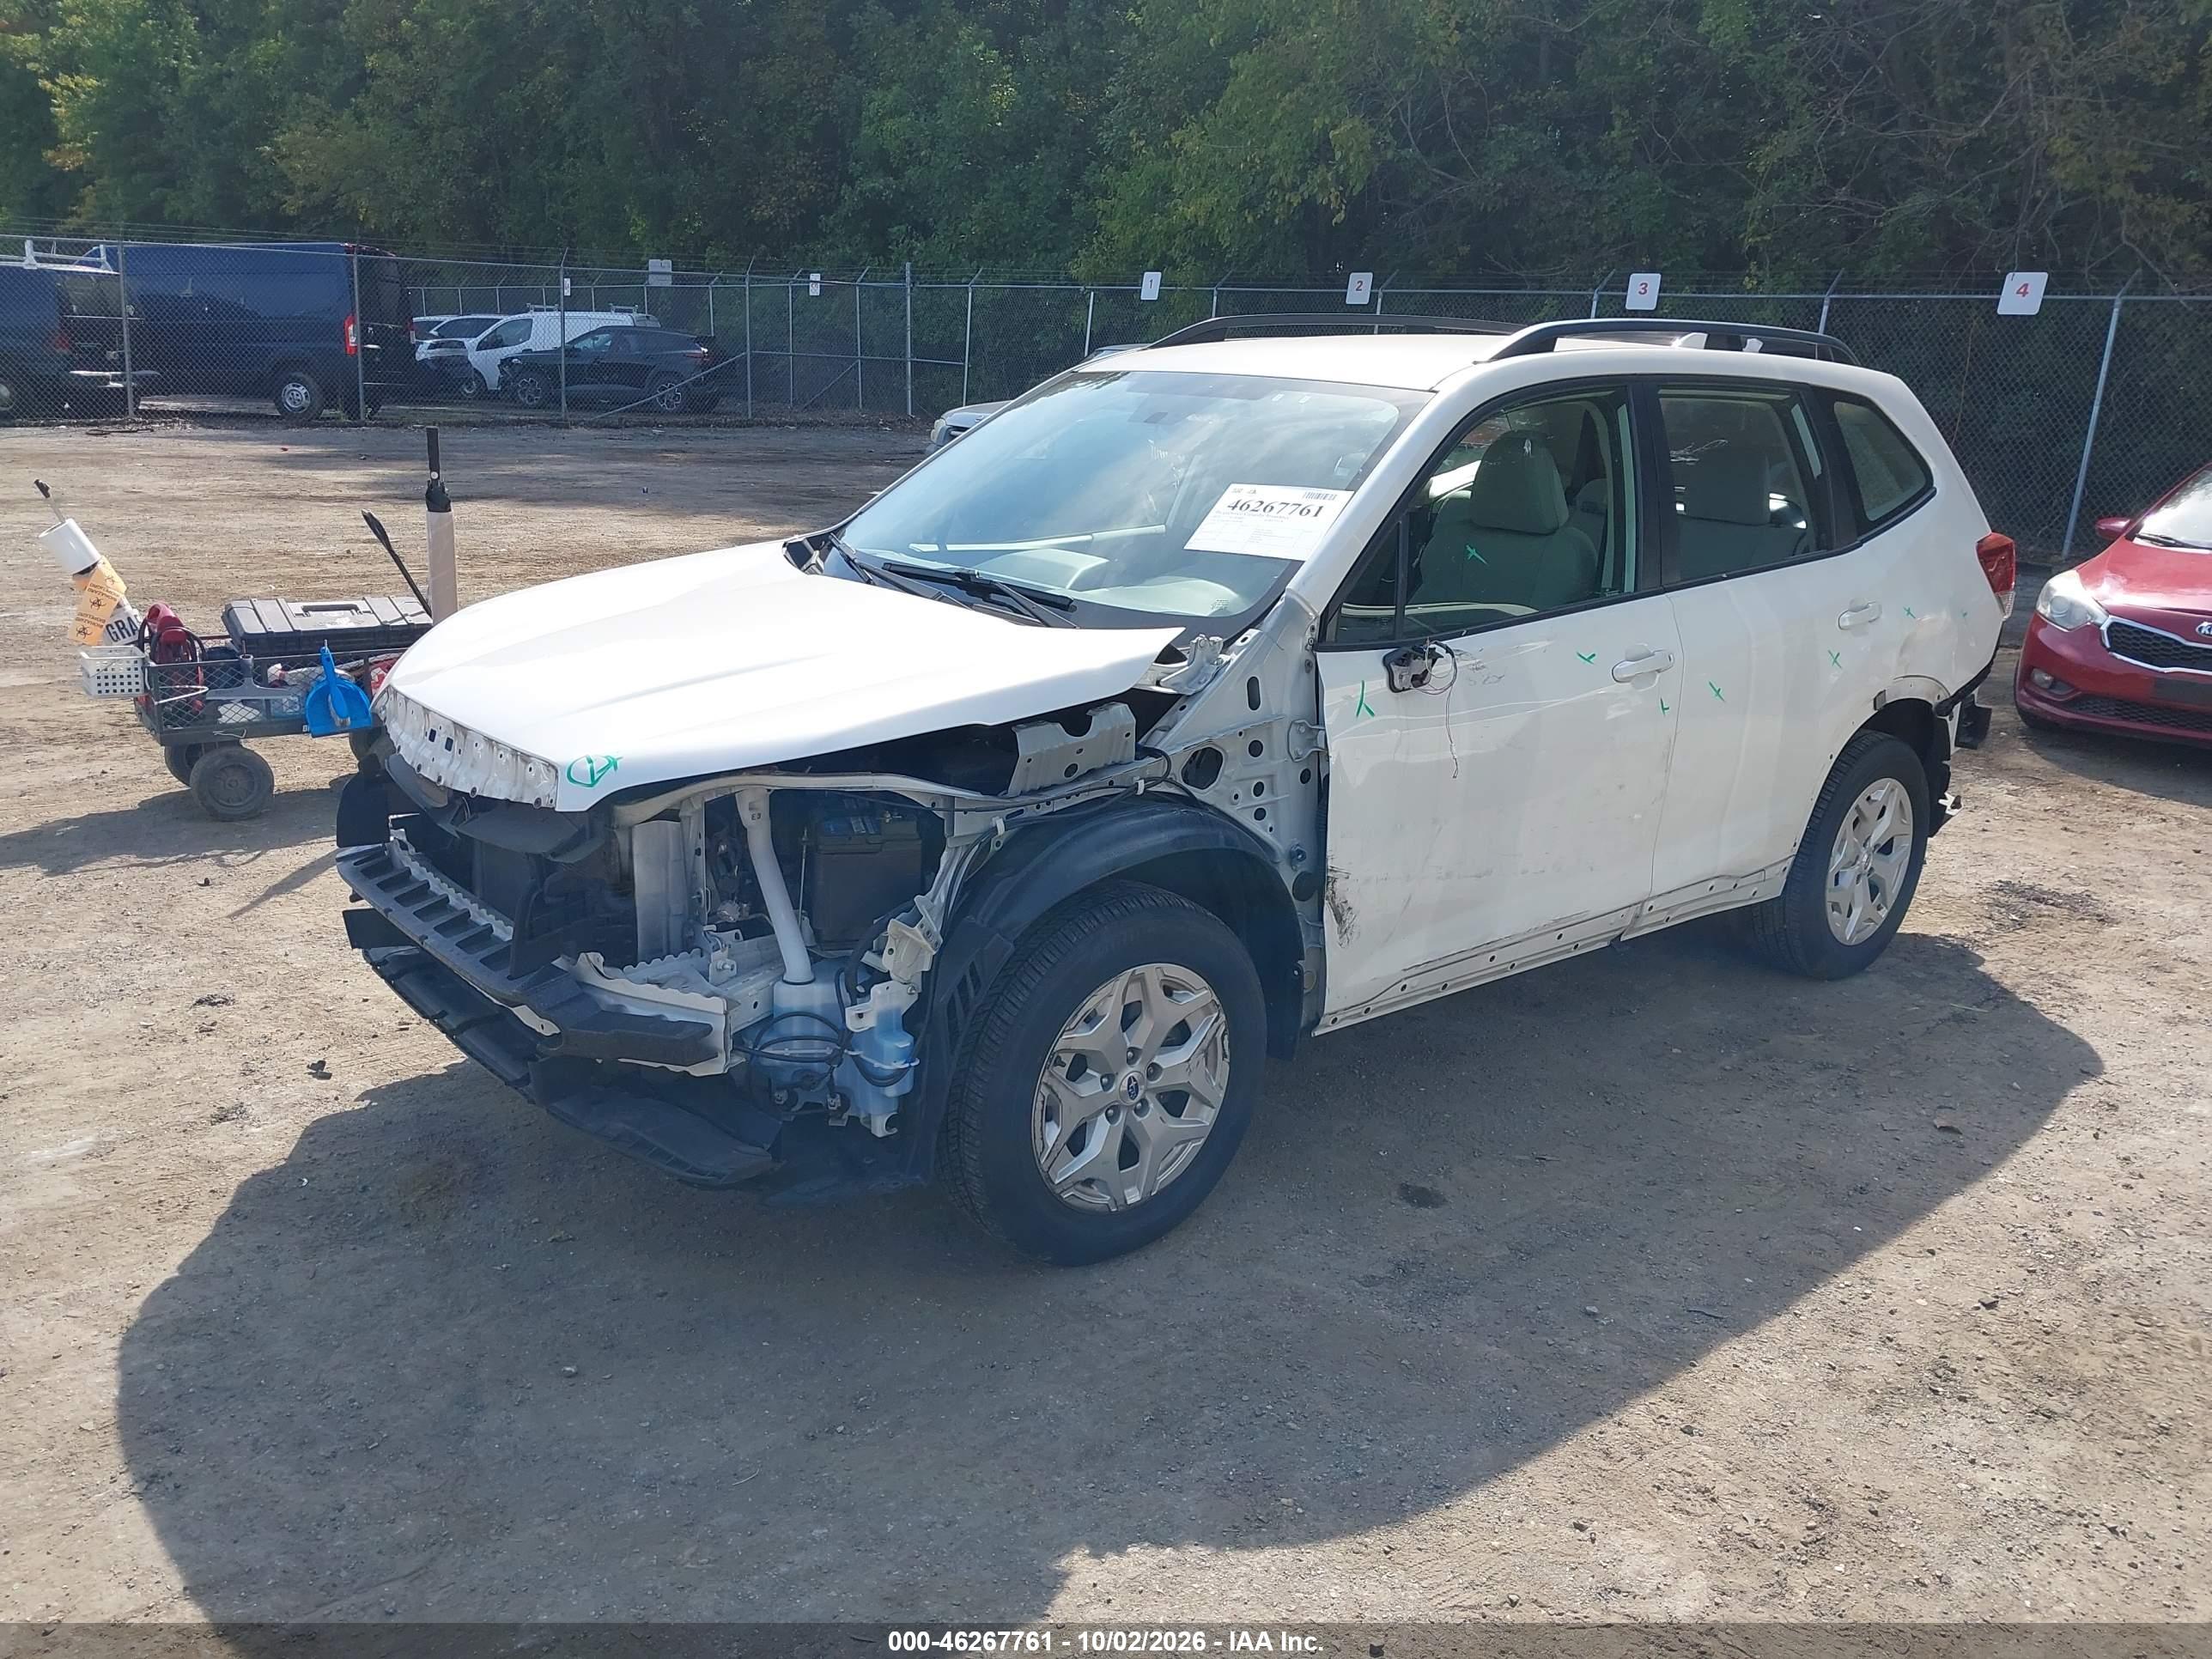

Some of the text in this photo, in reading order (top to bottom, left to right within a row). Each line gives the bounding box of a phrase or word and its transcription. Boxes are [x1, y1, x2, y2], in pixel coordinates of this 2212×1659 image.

[1355, 281, 1364, 291] 2
[1638, 282, 1649, 295] 3
[2015, 283, 2029, 297] 4
[1227, 499, 1324, 518] 46267761
